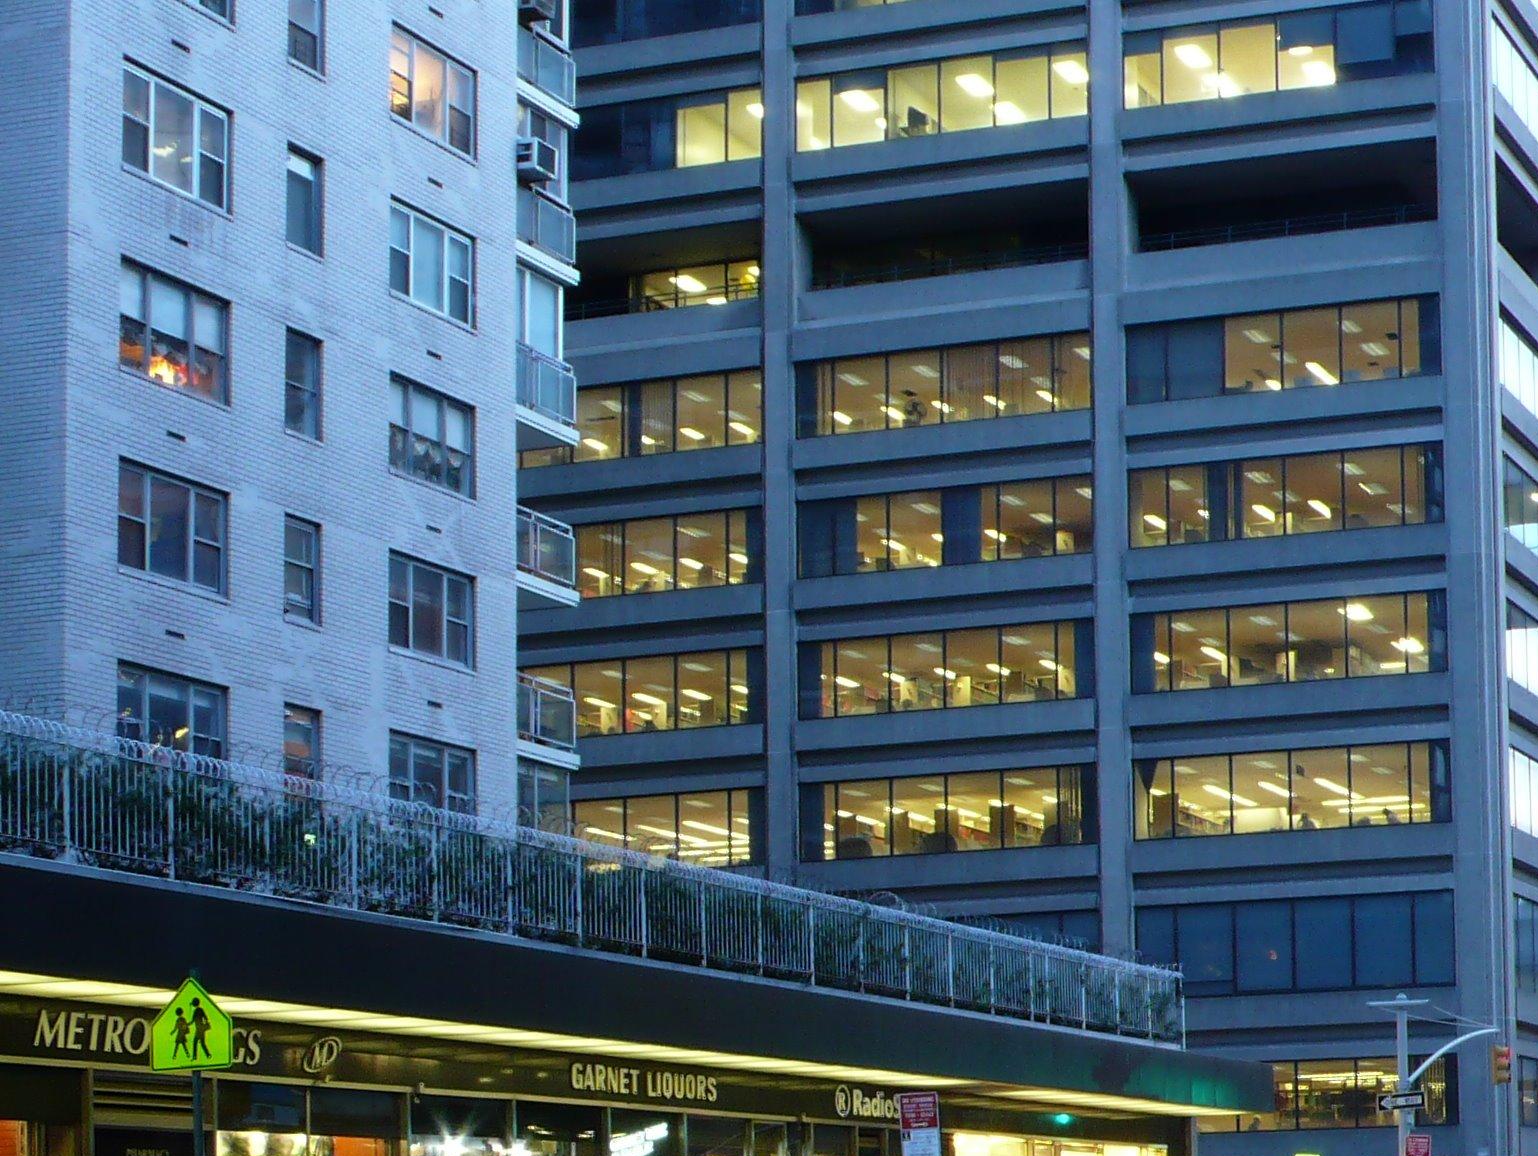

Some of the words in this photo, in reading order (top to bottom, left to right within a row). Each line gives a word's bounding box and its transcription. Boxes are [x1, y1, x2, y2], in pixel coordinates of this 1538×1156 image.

[33, 1009, 151, 1055] METRO
[571, 1063, 640, 1095] GARNET
[647, 1071, 718, 1102] LIQUORS
[853, 1088, 901, 1118] RadioS
